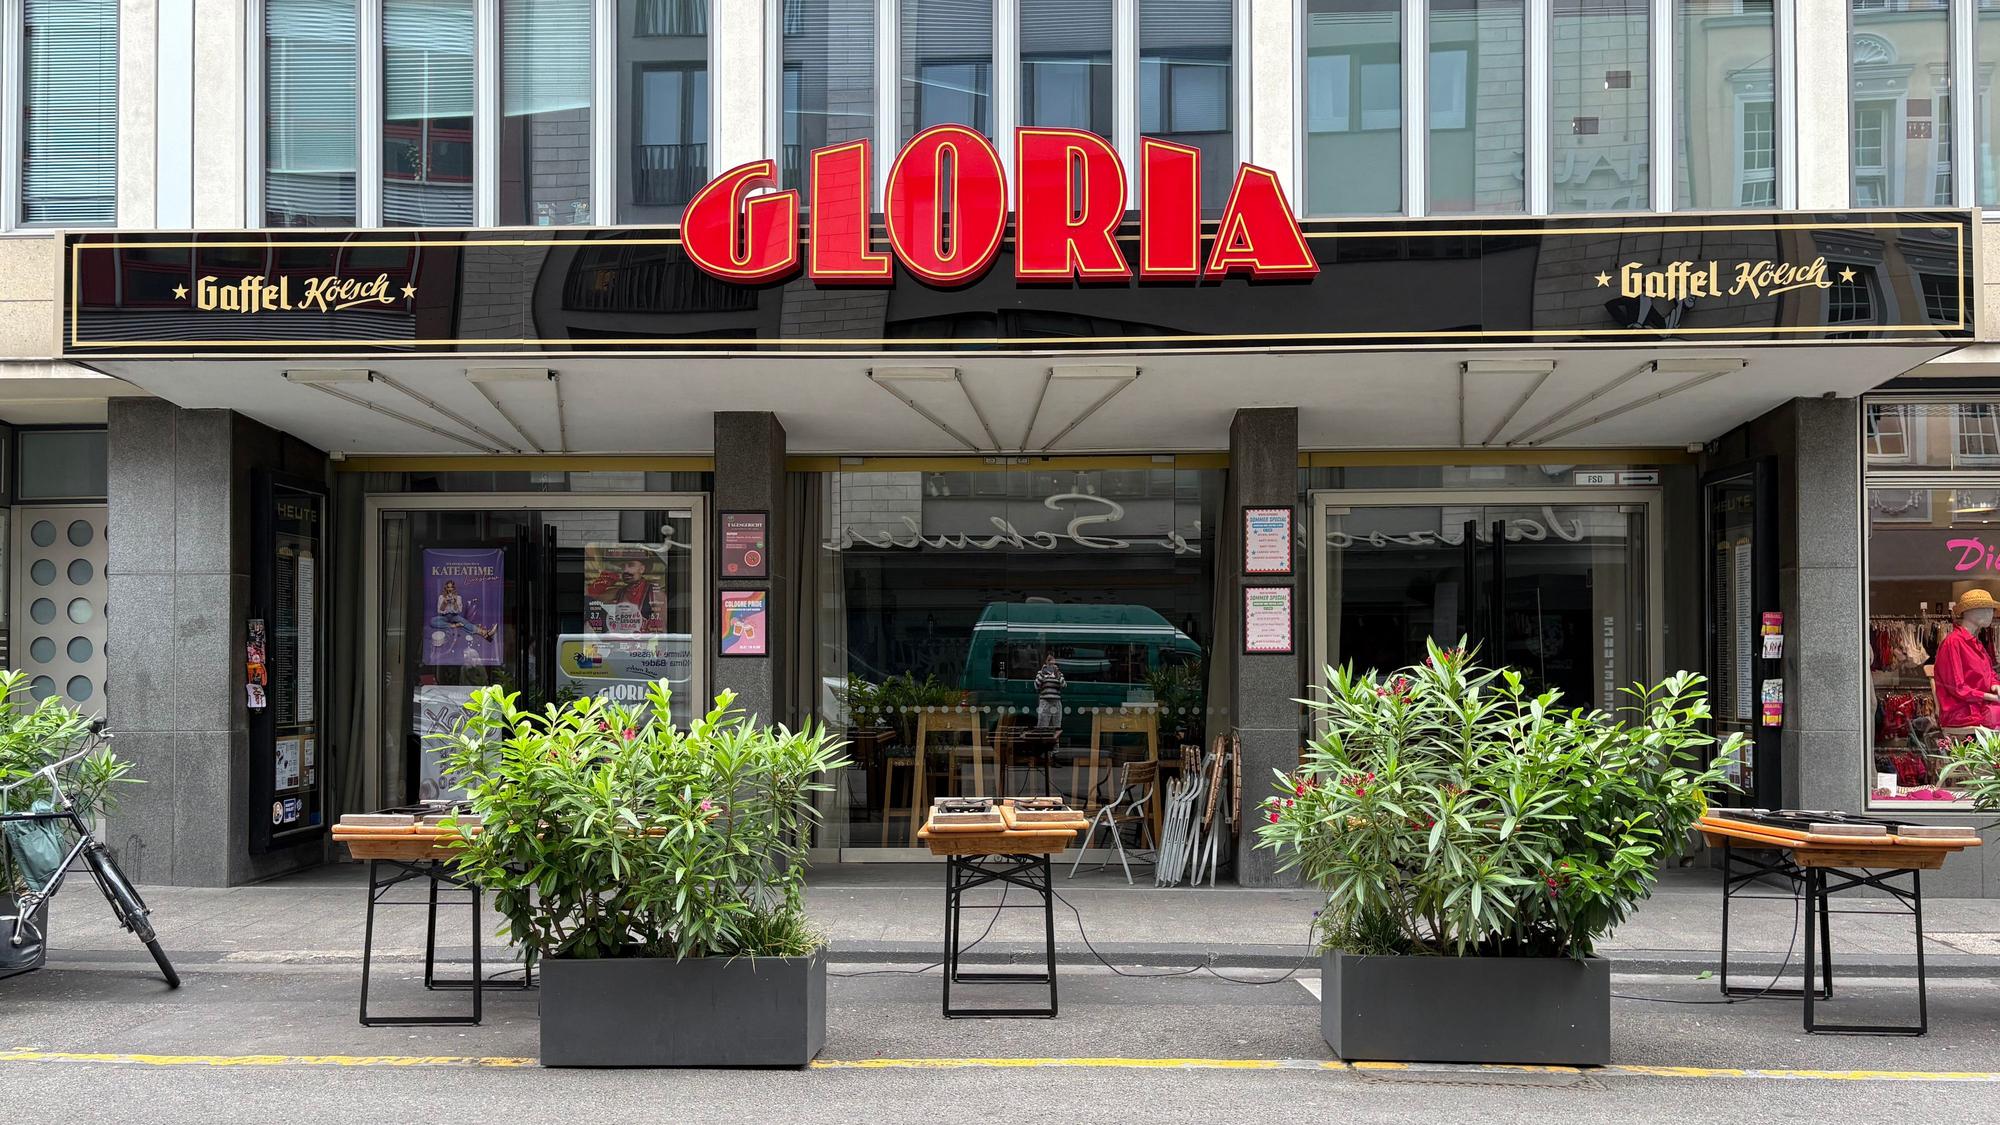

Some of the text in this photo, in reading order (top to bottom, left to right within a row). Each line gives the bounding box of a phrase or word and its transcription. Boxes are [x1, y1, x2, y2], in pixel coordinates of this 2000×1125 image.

[680, 123, 1320, 286] GLORIA
[1621, 256, 1834, 301] Gaffel Kölsch
[197, 273, 395, 313] Gaffel Kölsch
[1588, 475, 1603, 483] FSD
[277, 503, 317, 522] HEUTE
[724, 600, 763, 608] COLOGNE PRIDE
[597, 684, 651, 701] GLORIA
